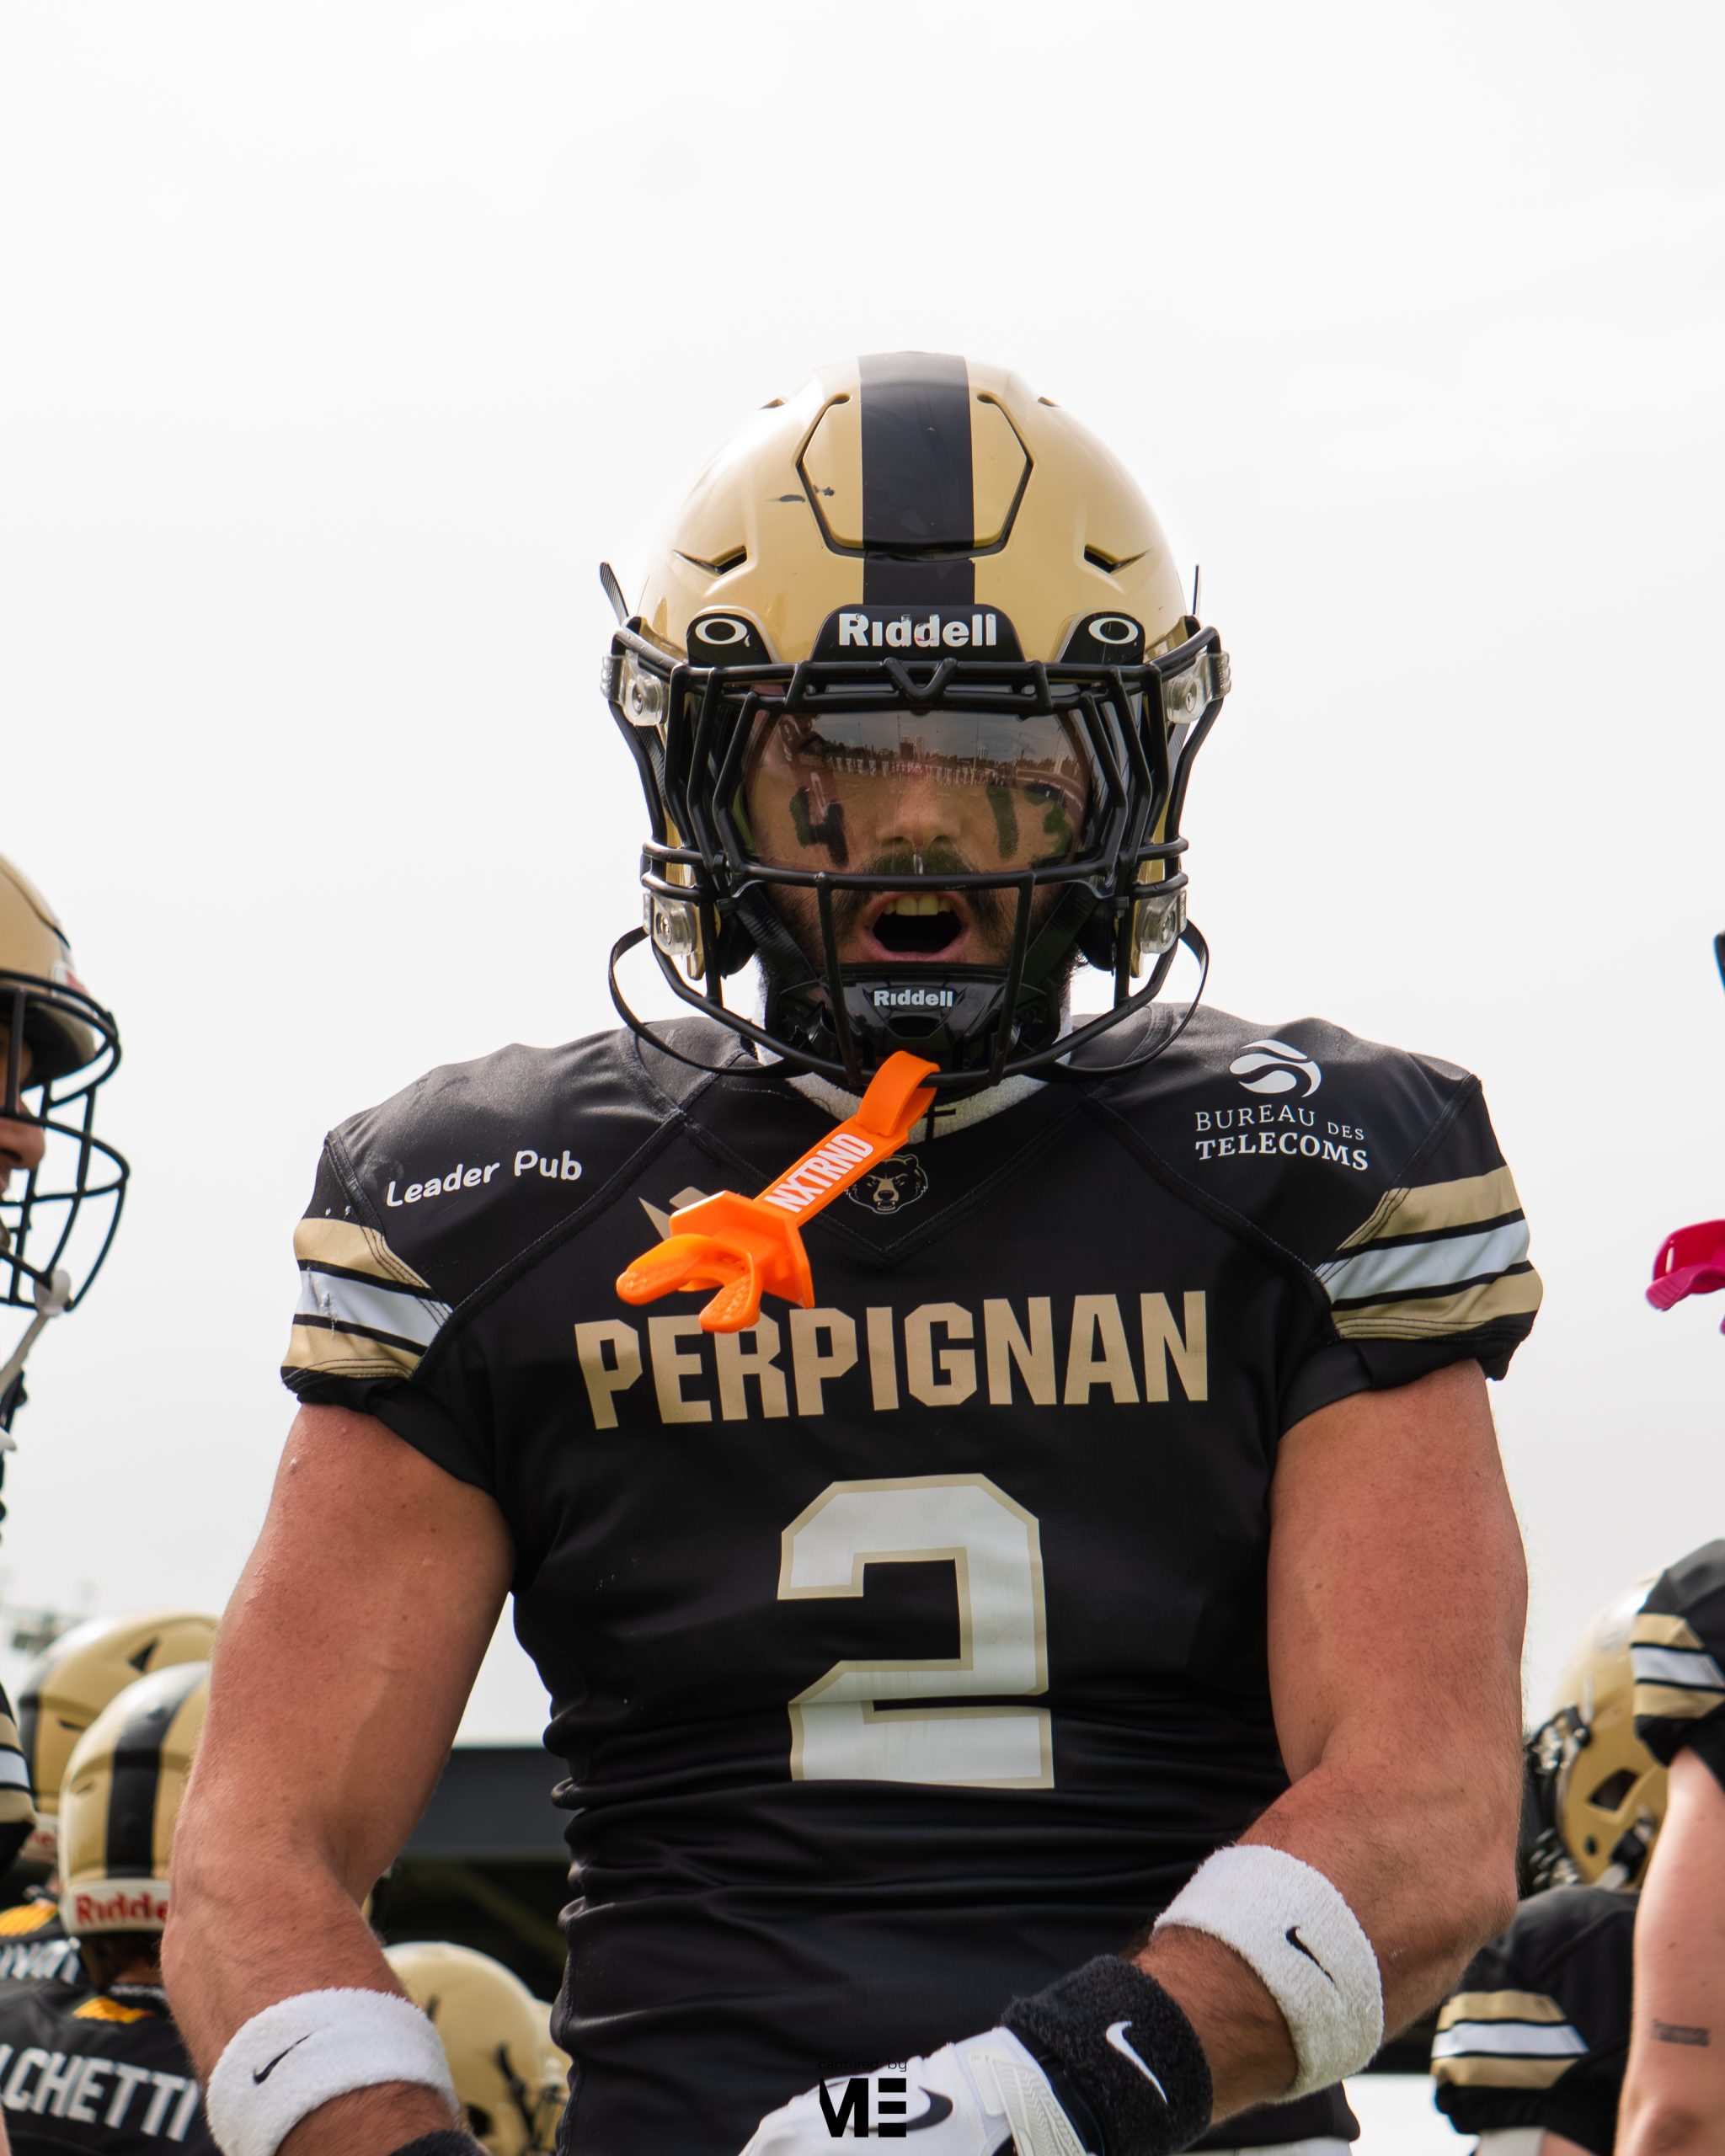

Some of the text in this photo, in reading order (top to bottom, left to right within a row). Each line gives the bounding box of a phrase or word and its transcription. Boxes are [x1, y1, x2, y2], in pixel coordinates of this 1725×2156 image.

[838, 613, 996, 646] Riddell
[874, 989, 953, 1007] Riddell
[1194, 1104, 1365, 1140] BUREAU DES
[763, 1133, 874, 1214] NXTRND
[1195, 1132, 1369, 1171] TELECOMS
[386, 1150, 582, 1208] Leader Pub
[574, 1290, 1208, 1429] PERPIGNAN
[777, 1473, 1055, 1789] 2
